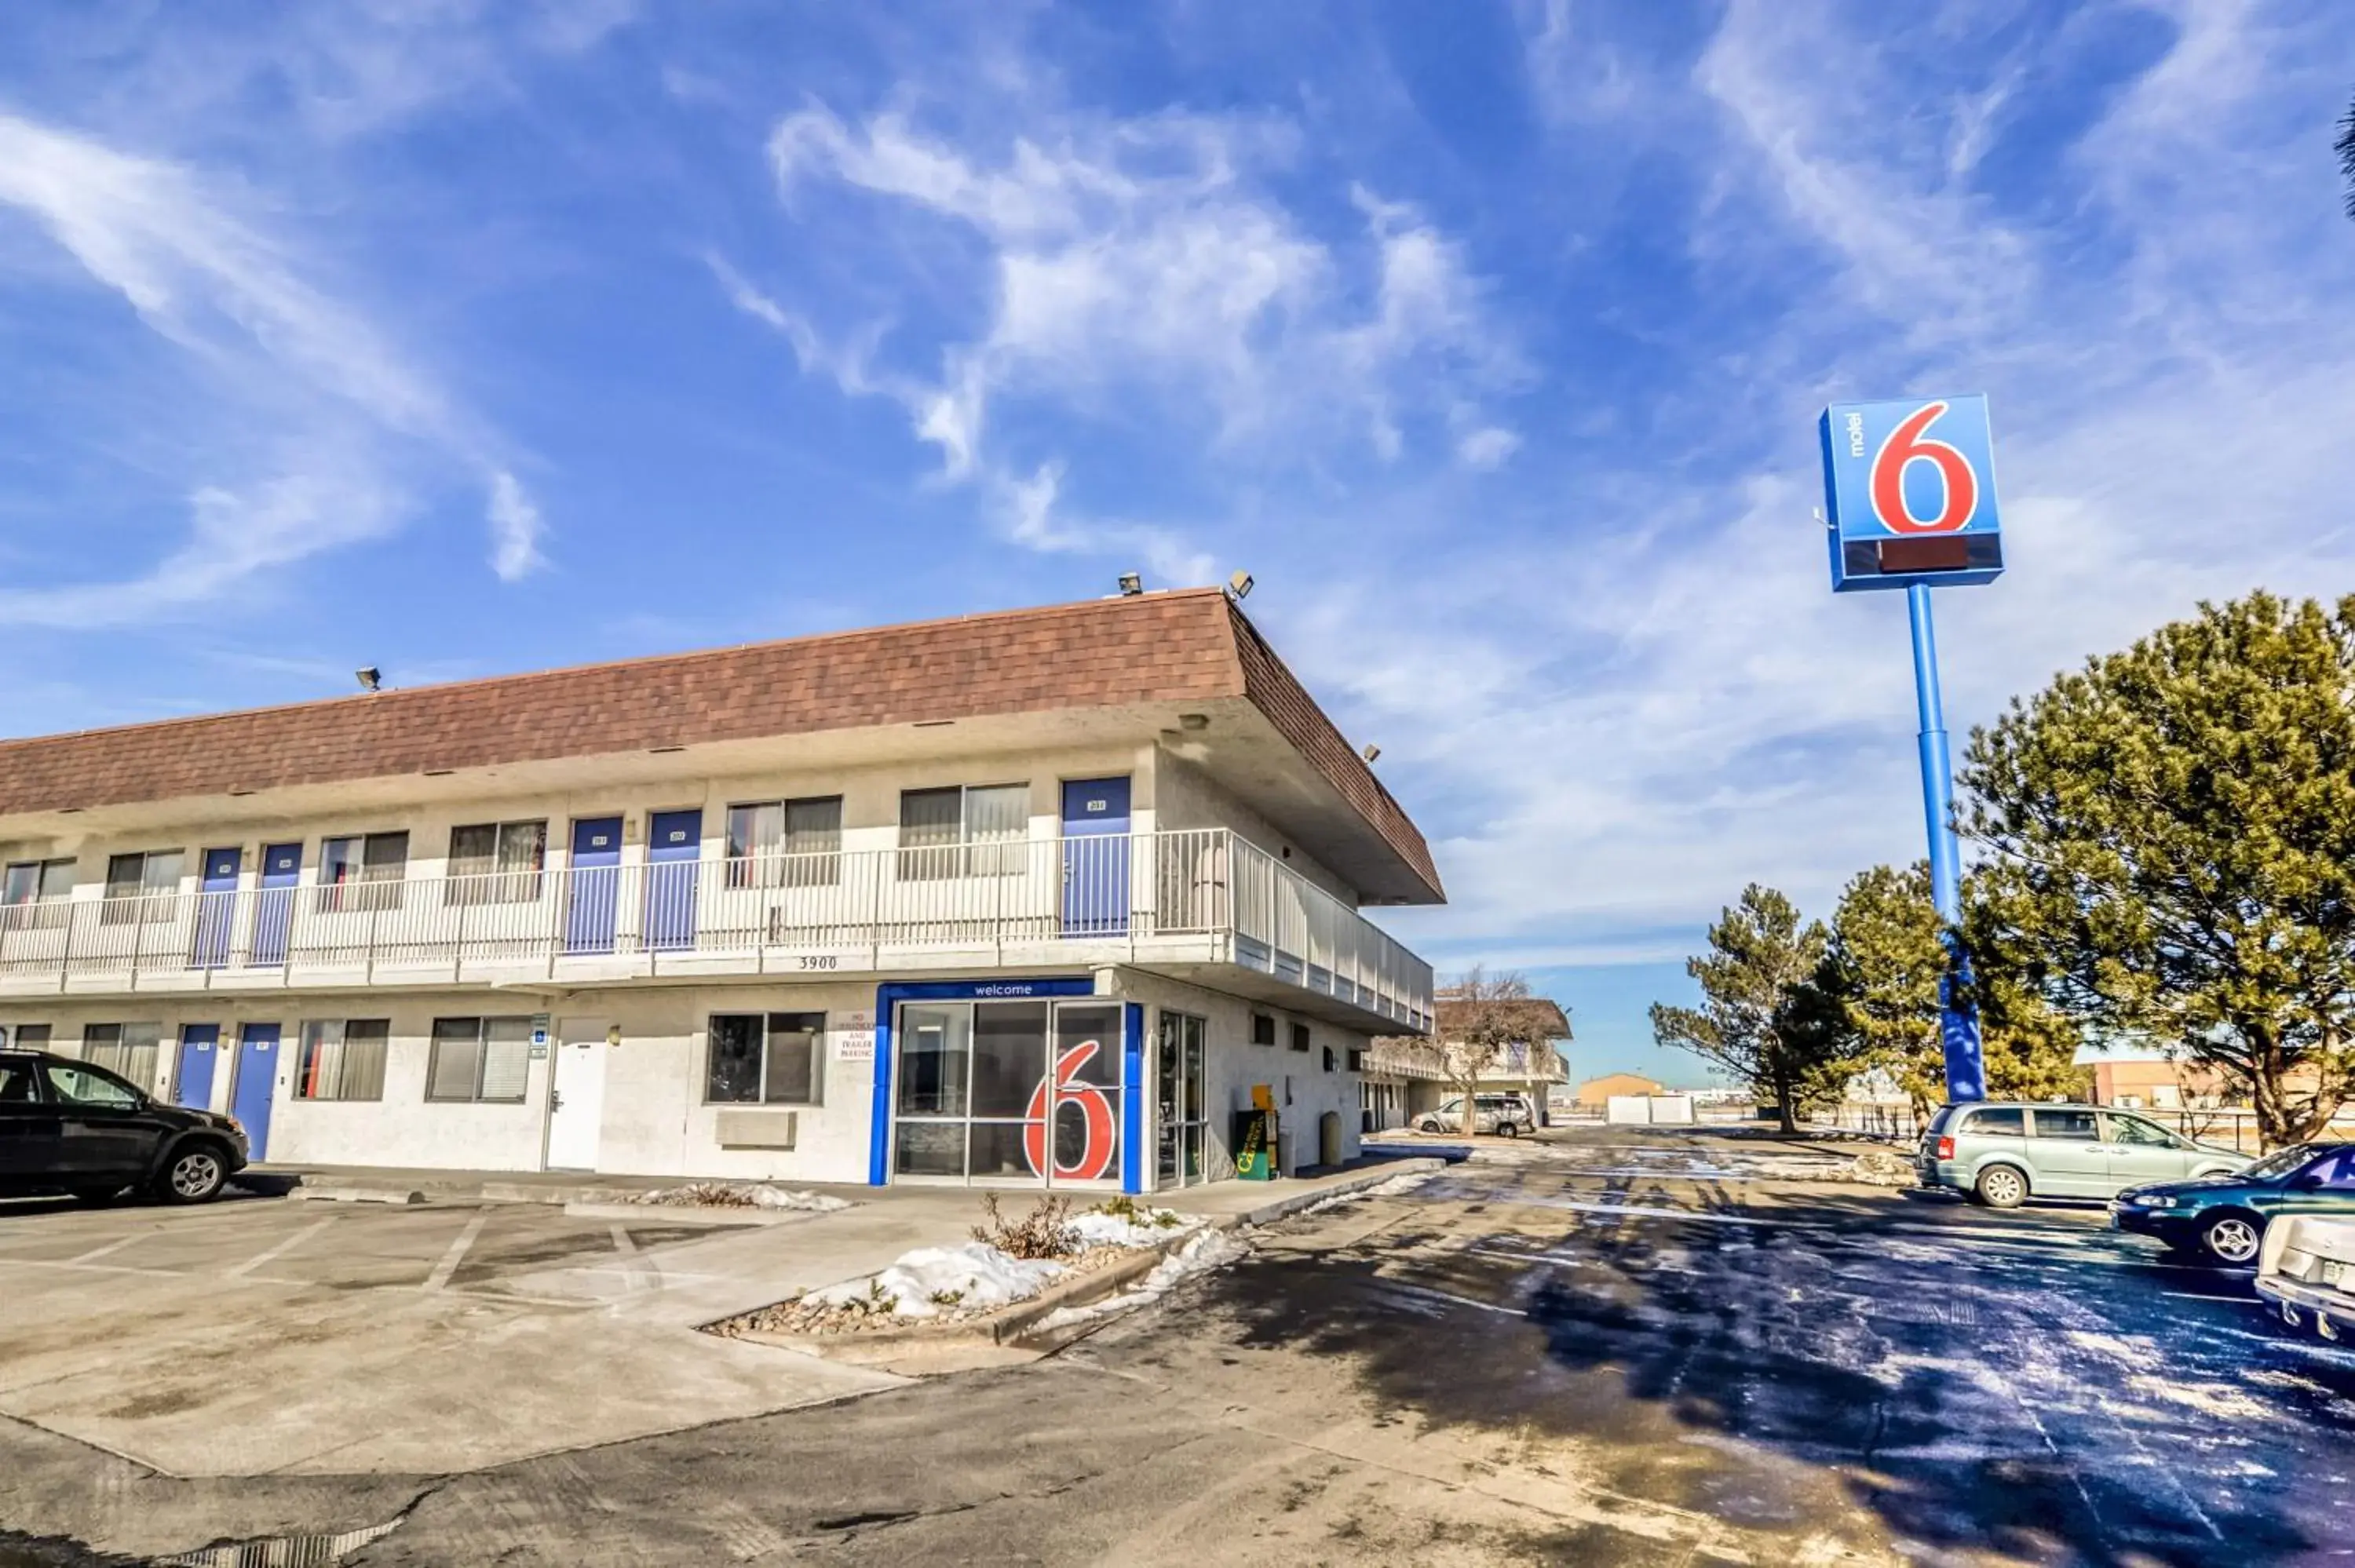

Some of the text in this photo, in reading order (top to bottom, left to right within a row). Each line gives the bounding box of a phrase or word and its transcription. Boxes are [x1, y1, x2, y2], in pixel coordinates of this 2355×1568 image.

[1845, 399, 1979, 535] motel 6
[800, 955, 837, 969] 3900
[974, 984, 1033, 996] welcome
[1023, 1039, 1115, 1180] 6
